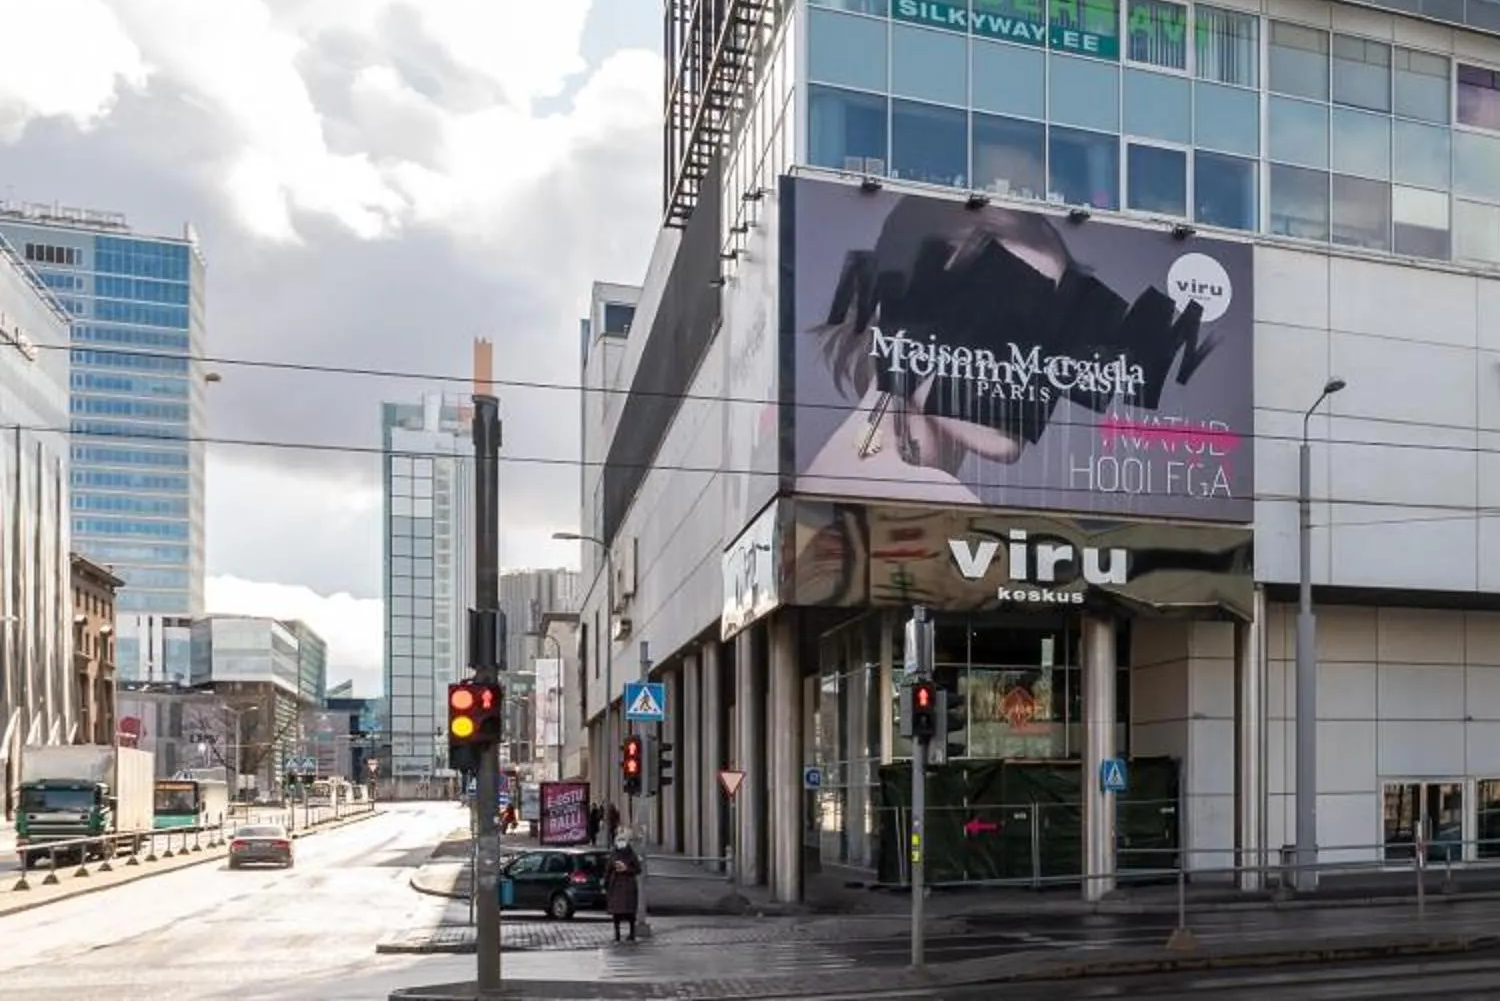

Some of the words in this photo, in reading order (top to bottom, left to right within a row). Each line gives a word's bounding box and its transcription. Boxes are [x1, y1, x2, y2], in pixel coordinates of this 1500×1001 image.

[1176, 278, 1223, 296] viru
[976, 380, 1051, 403] PARIS
[948, 528, 1127, 585] viru
[997, 586, 1084, 604] keskus
